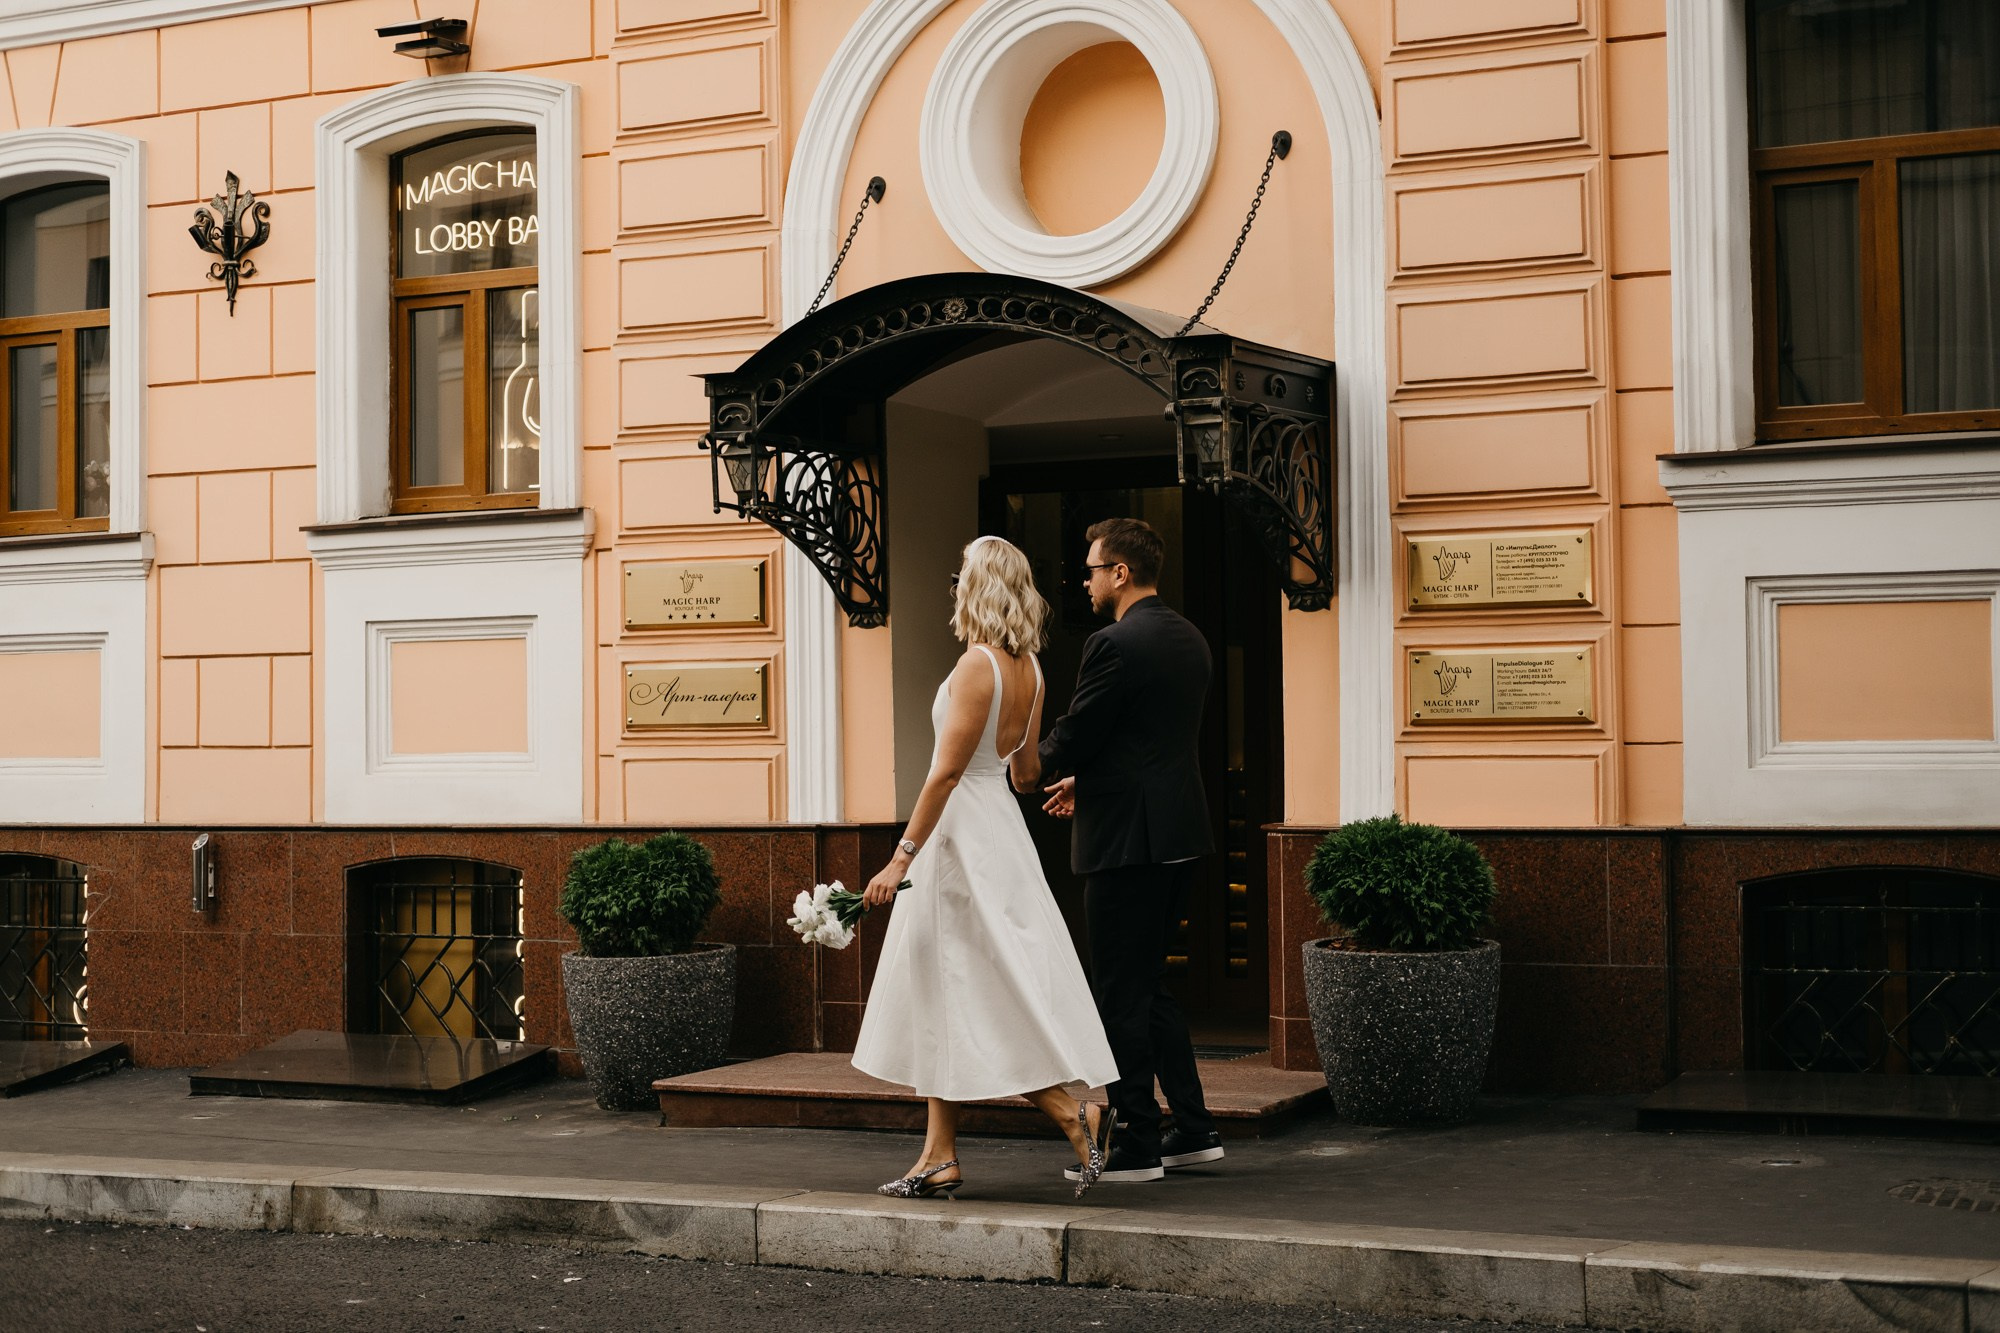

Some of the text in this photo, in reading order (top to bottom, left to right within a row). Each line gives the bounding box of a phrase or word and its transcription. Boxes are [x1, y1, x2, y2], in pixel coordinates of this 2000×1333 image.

[406, 162, 493, 210] MAGIC
[415, 219, 501, 254] LOBBY
[662, 596, 721, 606] MAGIC HARP
[630, 676, 758, 716] Арт-галерея
